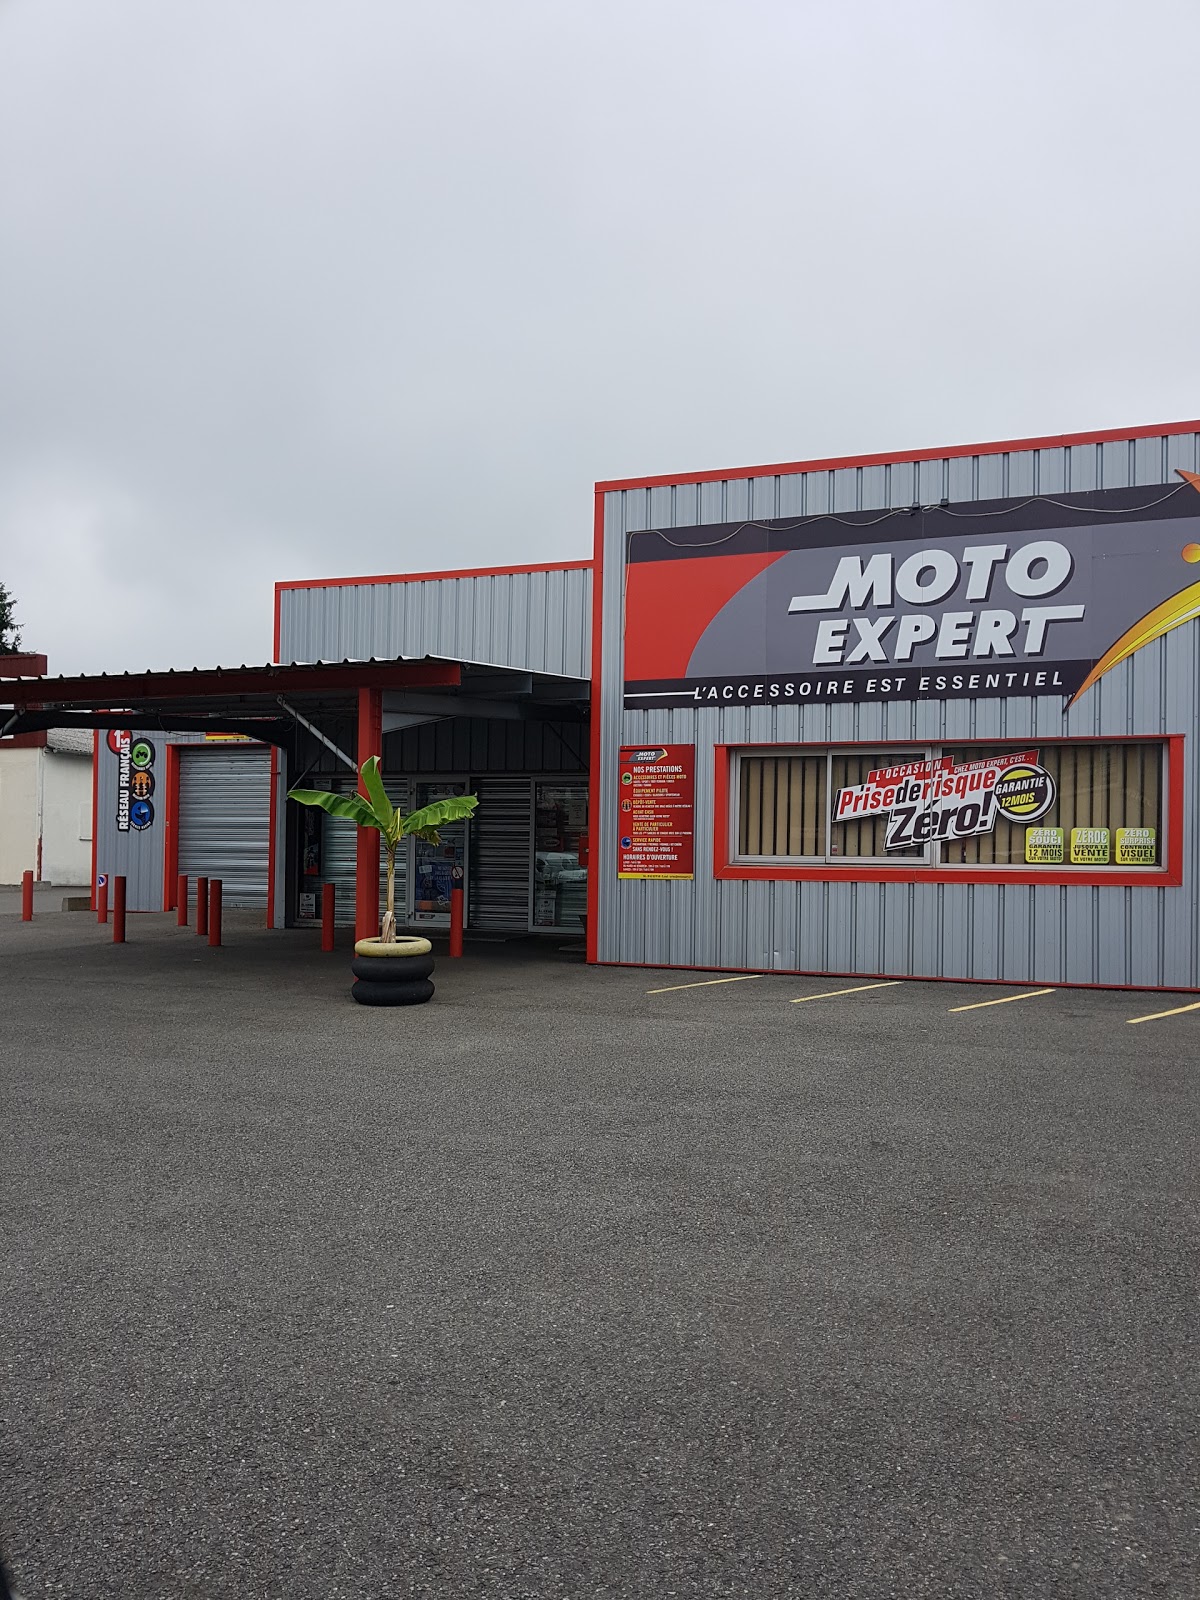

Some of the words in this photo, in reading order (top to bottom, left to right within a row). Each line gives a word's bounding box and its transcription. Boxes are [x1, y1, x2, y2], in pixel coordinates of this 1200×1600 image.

[788, 540, 1072, 612] MOTO
[812, 604, 1085, 664] EXPERT
[693, 680, 854, 700] L'ACCESSOIRE
[866, 677, 906, 694] EST
[918, 671, 1064, 692] ESSENTIEL
[119, 737, 132, 787] FRANÇAIS
[645, 765, 683, 773] PRESTATIONS
[953, 764, 968, 774] CHEZ
[968, 761, 986, 772] MOTO
[995, 776, 1046, 794] GARANTIE
[117, 789, 129, 830] RÉSEAU
[887, 790, 994, 846] Zéro!
[1032, 828, 1058, 837] ZÉRO
[1124, 828, 1150, 837] ZÉRO
[1028, 836, 1061, 845] SOUCI
[1119, 836, 1156, 845] SURPRISE
[622, 853, 646, 861] HORAIRES
[1028, 848, 1039, 857] 12
[1040, 848, 1063, 857] MOIS
[1073, 849, 1108, 857] VENTE
[1120, 849, 1155, 858] VISUEL
